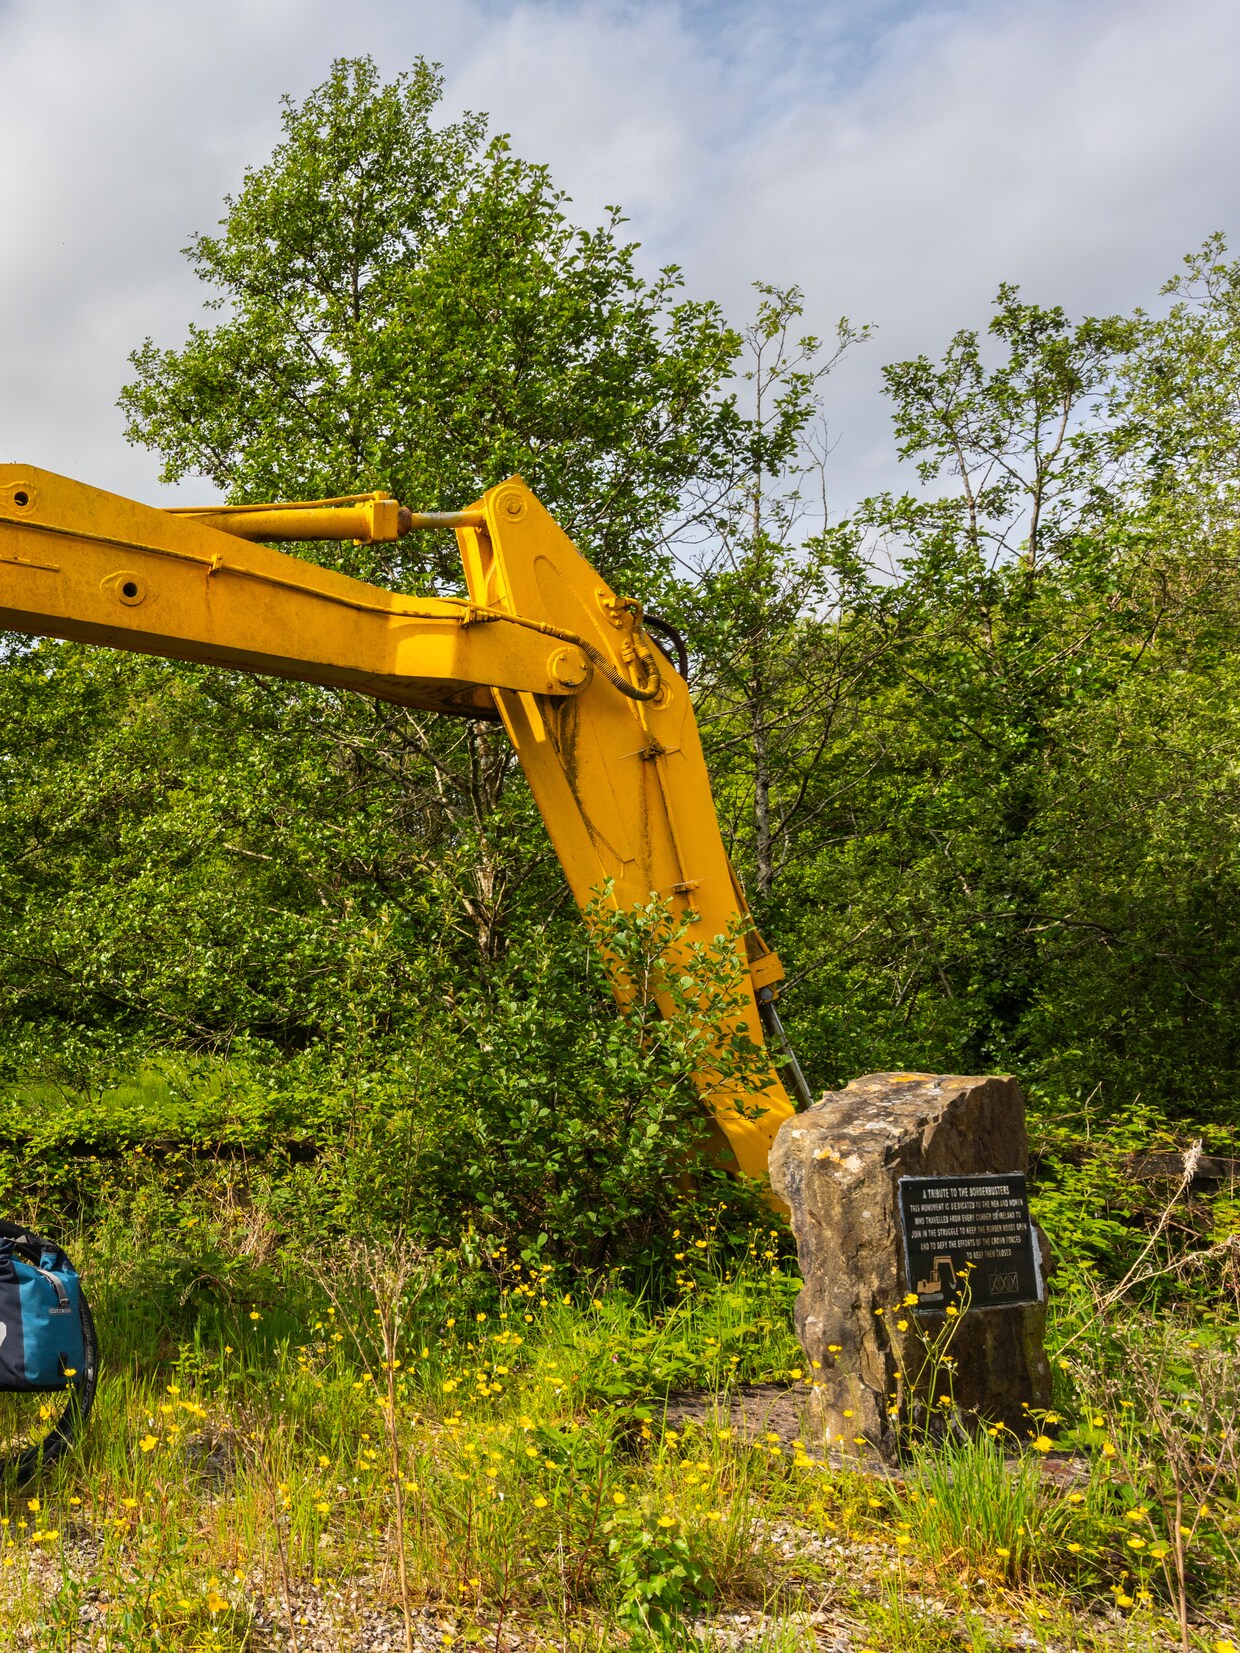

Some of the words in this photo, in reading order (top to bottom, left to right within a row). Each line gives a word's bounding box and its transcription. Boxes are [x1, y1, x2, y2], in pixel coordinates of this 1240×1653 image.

[923, 1189, 927, 1199] A
[927, 1188, 949, 1199] TRIBUTE
[950, 1187, 958, 1198] TO
[958, 1187, 968, 1197] THE
[969, 1185, 1009, 1197] BORDERBUSTERS
[910, 1204, 920, 1212] THIS
[920, 1203, 944, 1211] MONUMENT
[945, 1202, 950, 1210] IS
[950, 1201, 975, 1210] DEDICATED
[975, 1201, 981, 1209] TO
[981, 1200, 990, 1208] THE
[991, 1200, 999, 1208] MEN
[999, 1199, 1009, 1207] AND
[1009, 1198, 1023, 1206] WOMEN
[915, 1217, 925, 1225] WHO
[925, 1215, 949, 1224] TRAVELLED
[949, 1214, 960, 1223] FROM
[961, 1214, 975, 1222] EVERY
[999, 1211, 1015, 1219] IRELAND
[1015, 1211, 1021, 1219] TO
[911, 1230, 921, 1239] JOIN
[922, 1229, 928, 1238] IN
[928, 1229, 937, 1237] THE
[937, 1227, 959, 1236] STRUGGLE
[959, 1227, 965, 1235] TO
[966, 1226, 976, 1234] KEEP
[977, 1225, 985, 1233] THE
[986, 1224, 1002, 1233] BORDER
[1016, 1222, 1027, 1231] OPEN
[920, 1242, 930, 1250] AND
[930, 1242, 936, 1250] TO
[936, 1241, 948, 1250] DEFY
[948, 1240, 957, 1249] THE
[957, 1238, 975, 1248] EFFORTS
[976, 1238, 981, 1246] OF
[982, 1237, 990, 1246] THE
[991, 1236, 1006, 1245] CROWN
[1006, 1235, 1021, 1244] FORCES
[966, 1251, 973, 1260] TO
[973, 1250, 983, 1259] KEEP
[995, 1248, 1011, 1257] CLOSED
